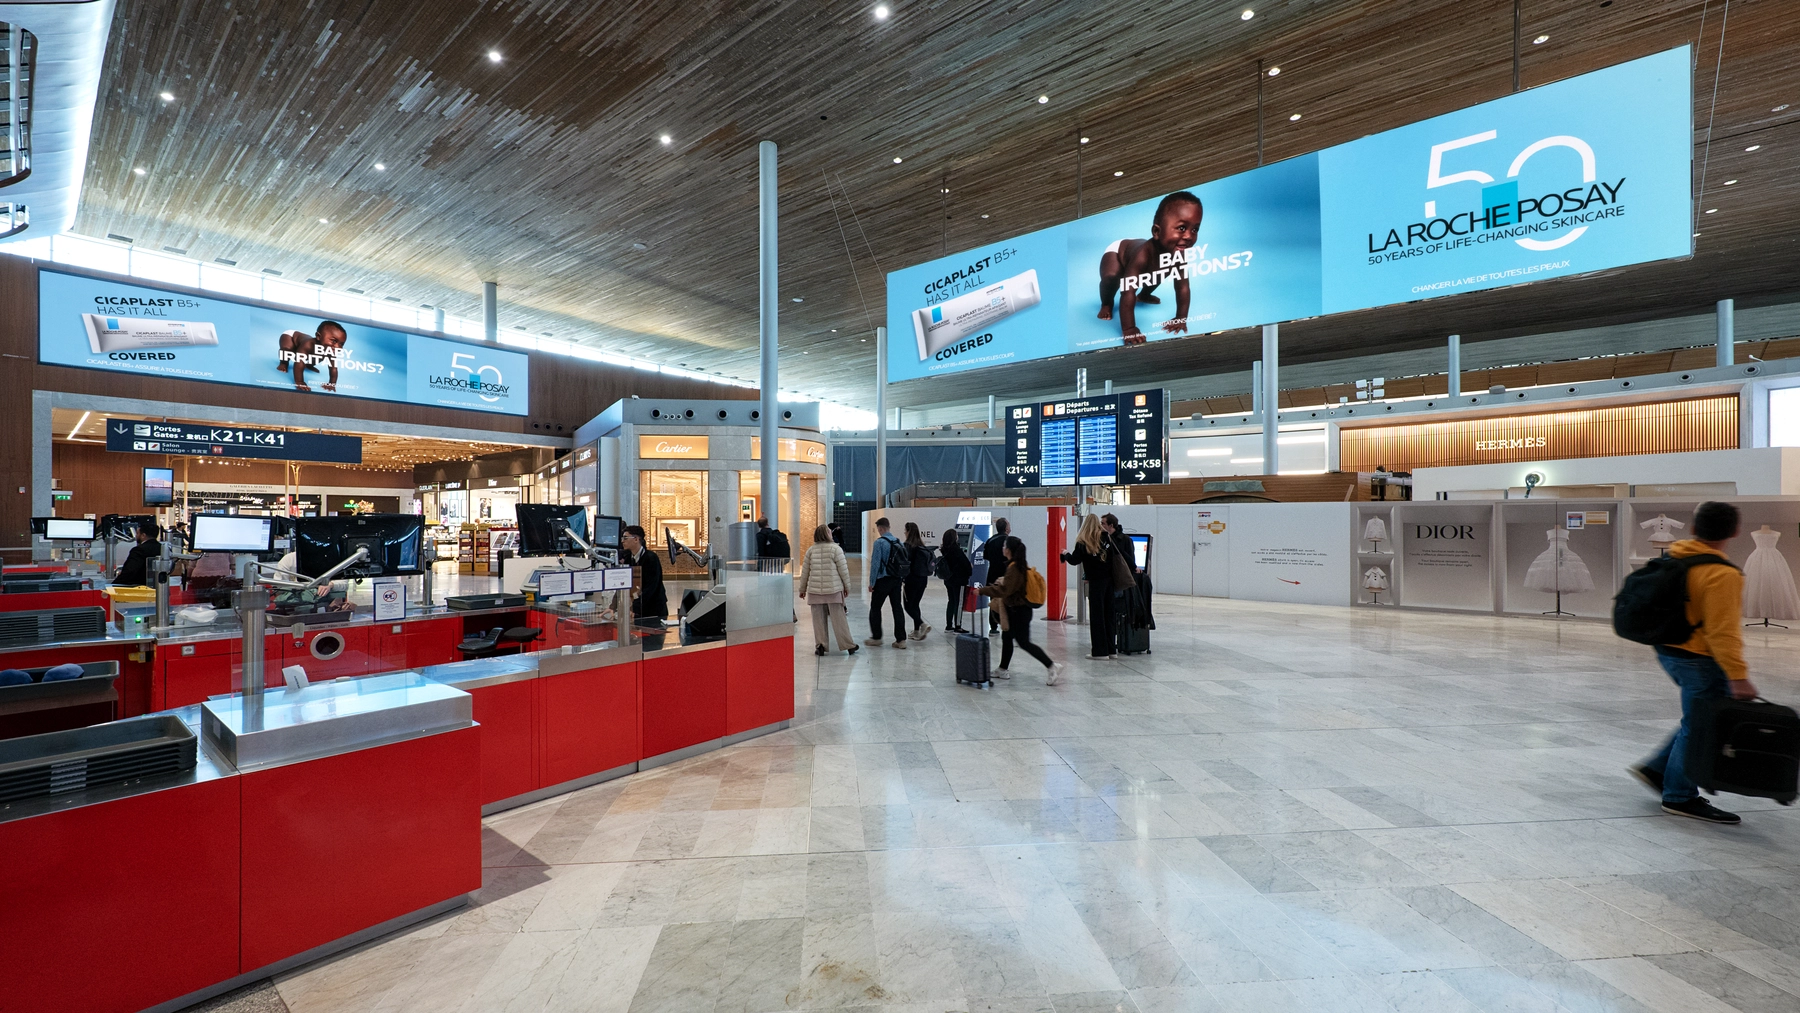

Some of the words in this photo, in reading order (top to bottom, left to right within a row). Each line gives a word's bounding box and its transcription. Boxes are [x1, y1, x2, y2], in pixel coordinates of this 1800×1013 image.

[1369, 229, 1402, 253] LA
[1408, 204, 1510, 246] ROCHE
[1518, 178, 1626, 223] POSAY
[1368, 255, 1382, 265] 50
[1384, 247, 1423, 261] YEARS
[1426, 243, 1443, 254] OF
[1446, 221, 1548, 251] LIFE-CHANGING
[1552, 206, 1625, 230] SKINCARE
[1159, 243, 1208, 270] BABY
[924, 256, 991, 294] CICAPLAST
[994, 248, 1018, 265] B5+
[1120, 250, 1253, 292] IRRITATIONS?
[1412, 281, 1450, 293] CHANGER
[1462, 276, 1475, 285] VIE
[1488, 268, 1521, 281] TOUTES
[1523, 266, 1538, 275] LES
[1540, 260, 1570, 273] PEAUX
[926, 290, 950, 306] HAS
[951, 284, 962, 298] IT
[964, 275, 985, 292] ALL
[95, 296, 173, 307] CICAPLAST
[177, 299, 201, 308] B5+
[991, 296, 1006, 307] B5+
[97, 306, 125, 315] HAS
[129, 307, 139, 315] IT
[144, 308, 167, 316] ALL
[1152, 318, 1186, 328] IRRITATIONS
[1197, 313, 1212, 322] BÉBÉ
[314, 344, 353, 359] BABY
[935, 333, 993, 361] COVERED
[109, 352, 176, 361] COVERED
[280, 350, 384, 374] IRRITATIONS?
[86, 358, 122, 368] CICAPLAST
[135, 364, 160, 372] ASSURE
[430, 375, 443, 385] LA
[444, 377, 478, 390] ROCHE
[480, 382, 510, 393] POSAY
[457, 388, 489, 396] LIFE-CHANGING
[1066, 401, 1089, 410] Départs
[1066, 406, 1099, 414] Departures
[210, 429, 285, 446] K21-K41
[656, 441, 692, 453] Cartier
[807, 446, 824, 459] Cartier
[1006, 466, 1038, 474] K21-K41
[1121, 459, 1161, 470] K43-K58
[1416, 525, 1475, 539] DIOR
